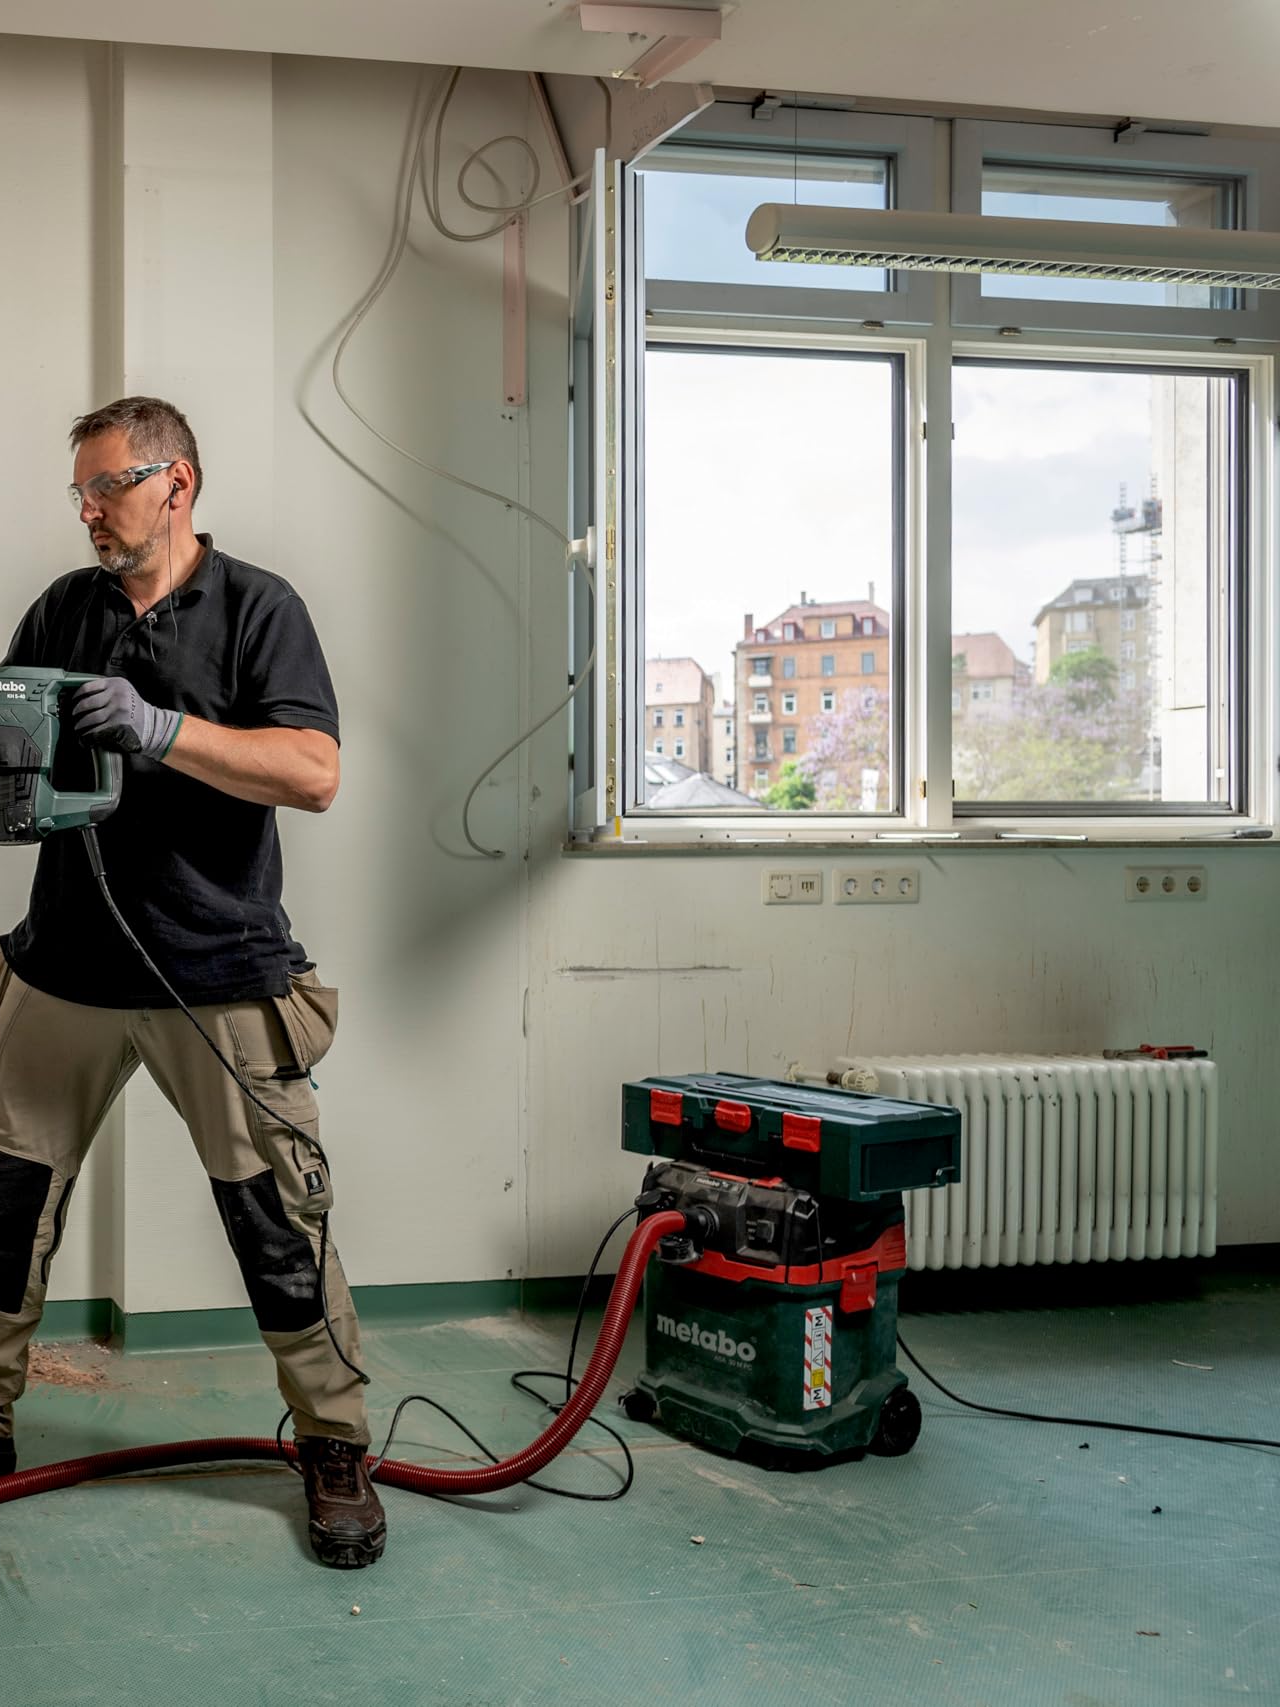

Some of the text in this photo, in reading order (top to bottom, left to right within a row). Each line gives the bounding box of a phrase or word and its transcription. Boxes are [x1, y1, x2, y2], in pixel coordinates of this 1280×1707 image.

[815, 1315, 823, 1327] M
[656, 1313, 756, 1362] metabo
[813, 1388, 821, 1400] M
